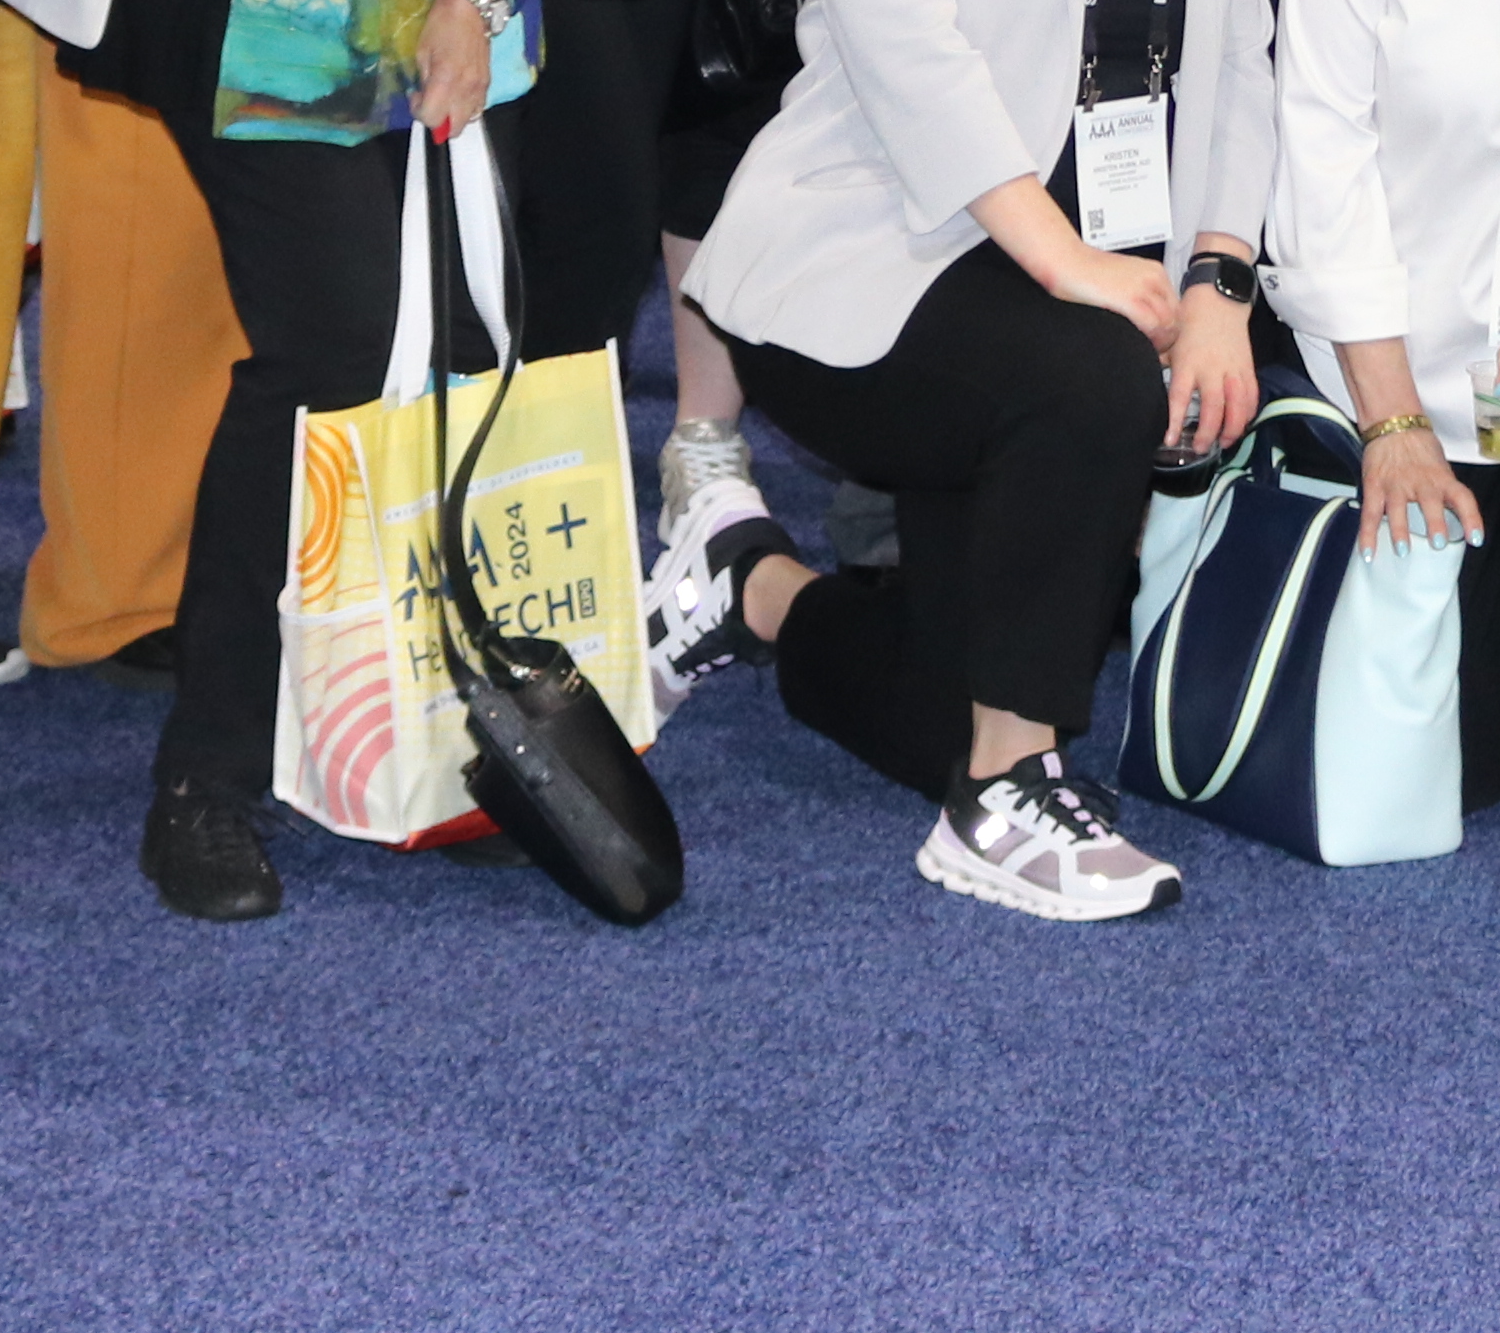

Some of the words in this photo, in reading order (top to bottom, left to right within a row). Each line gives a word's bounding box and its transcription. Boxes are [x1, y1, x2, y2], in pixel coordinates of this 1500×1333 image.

[1089, 120, 1116, 140] AAA
[1118, 114, 1155, 128] ANNUAL
[505, 500, 532, 580] 2024
